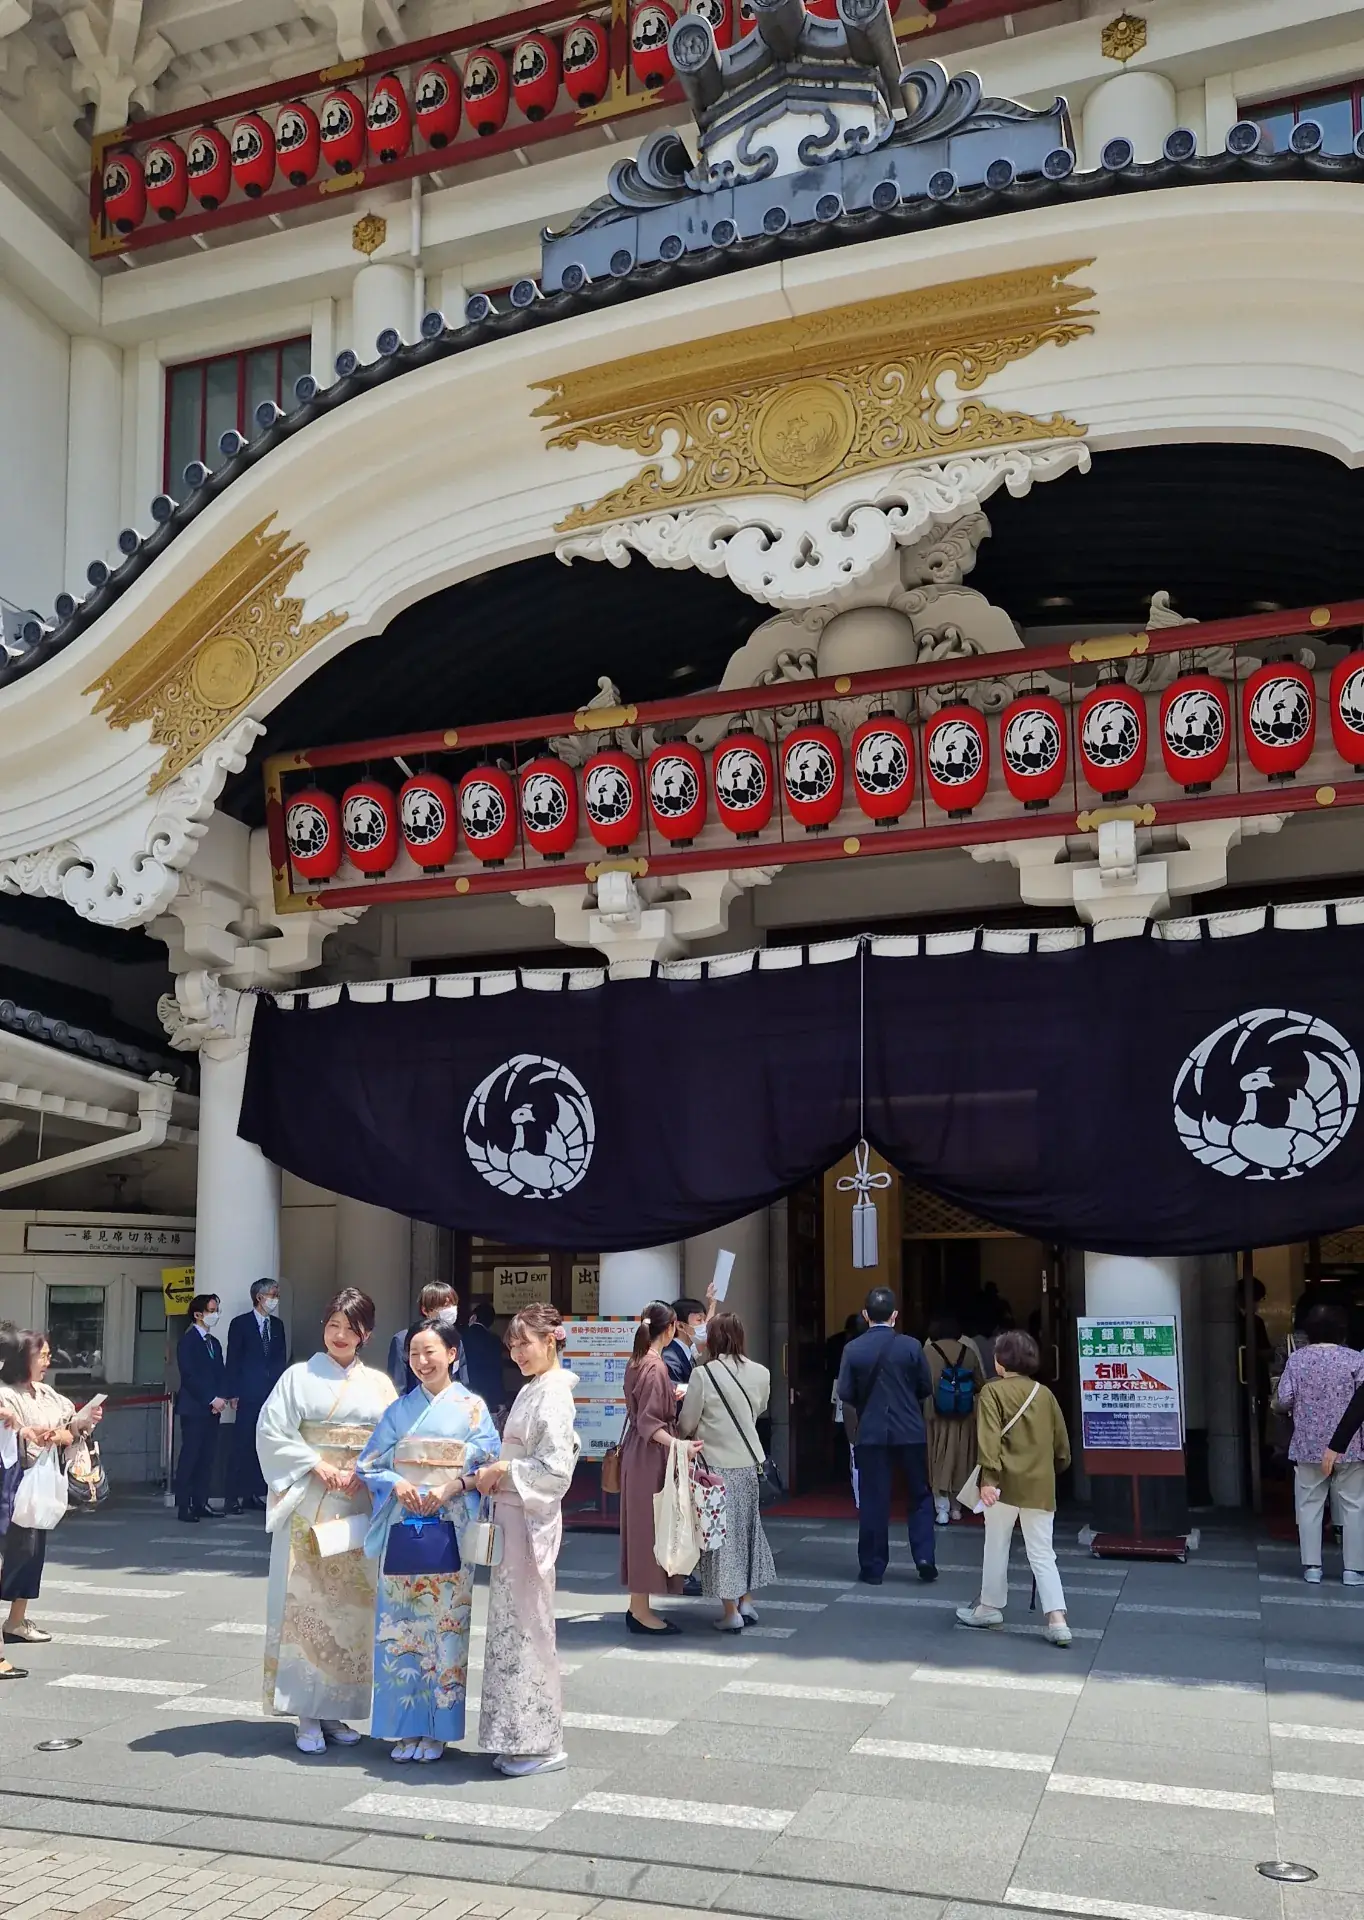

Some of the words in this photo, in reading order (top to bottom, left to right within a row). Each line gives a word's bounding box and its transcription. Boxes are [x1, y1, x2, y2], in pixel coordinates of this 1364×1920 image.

[65, 1229, 181, 1244] 一幕見席切符売場
[500, 1269, 529, 1286] 出口
[530, 1273, 548, 1282] EXIT
[571, 1326, 635, 1334] 感染予防対策について
[1081, 1327, 1157, 1340] 東銀座駅
[1082, 1343, 1145, 1355] お土産広場
[1095, 1363, 1138, 1379] 右側へ
[1094, 1380, 1158, 1390] お進みください
